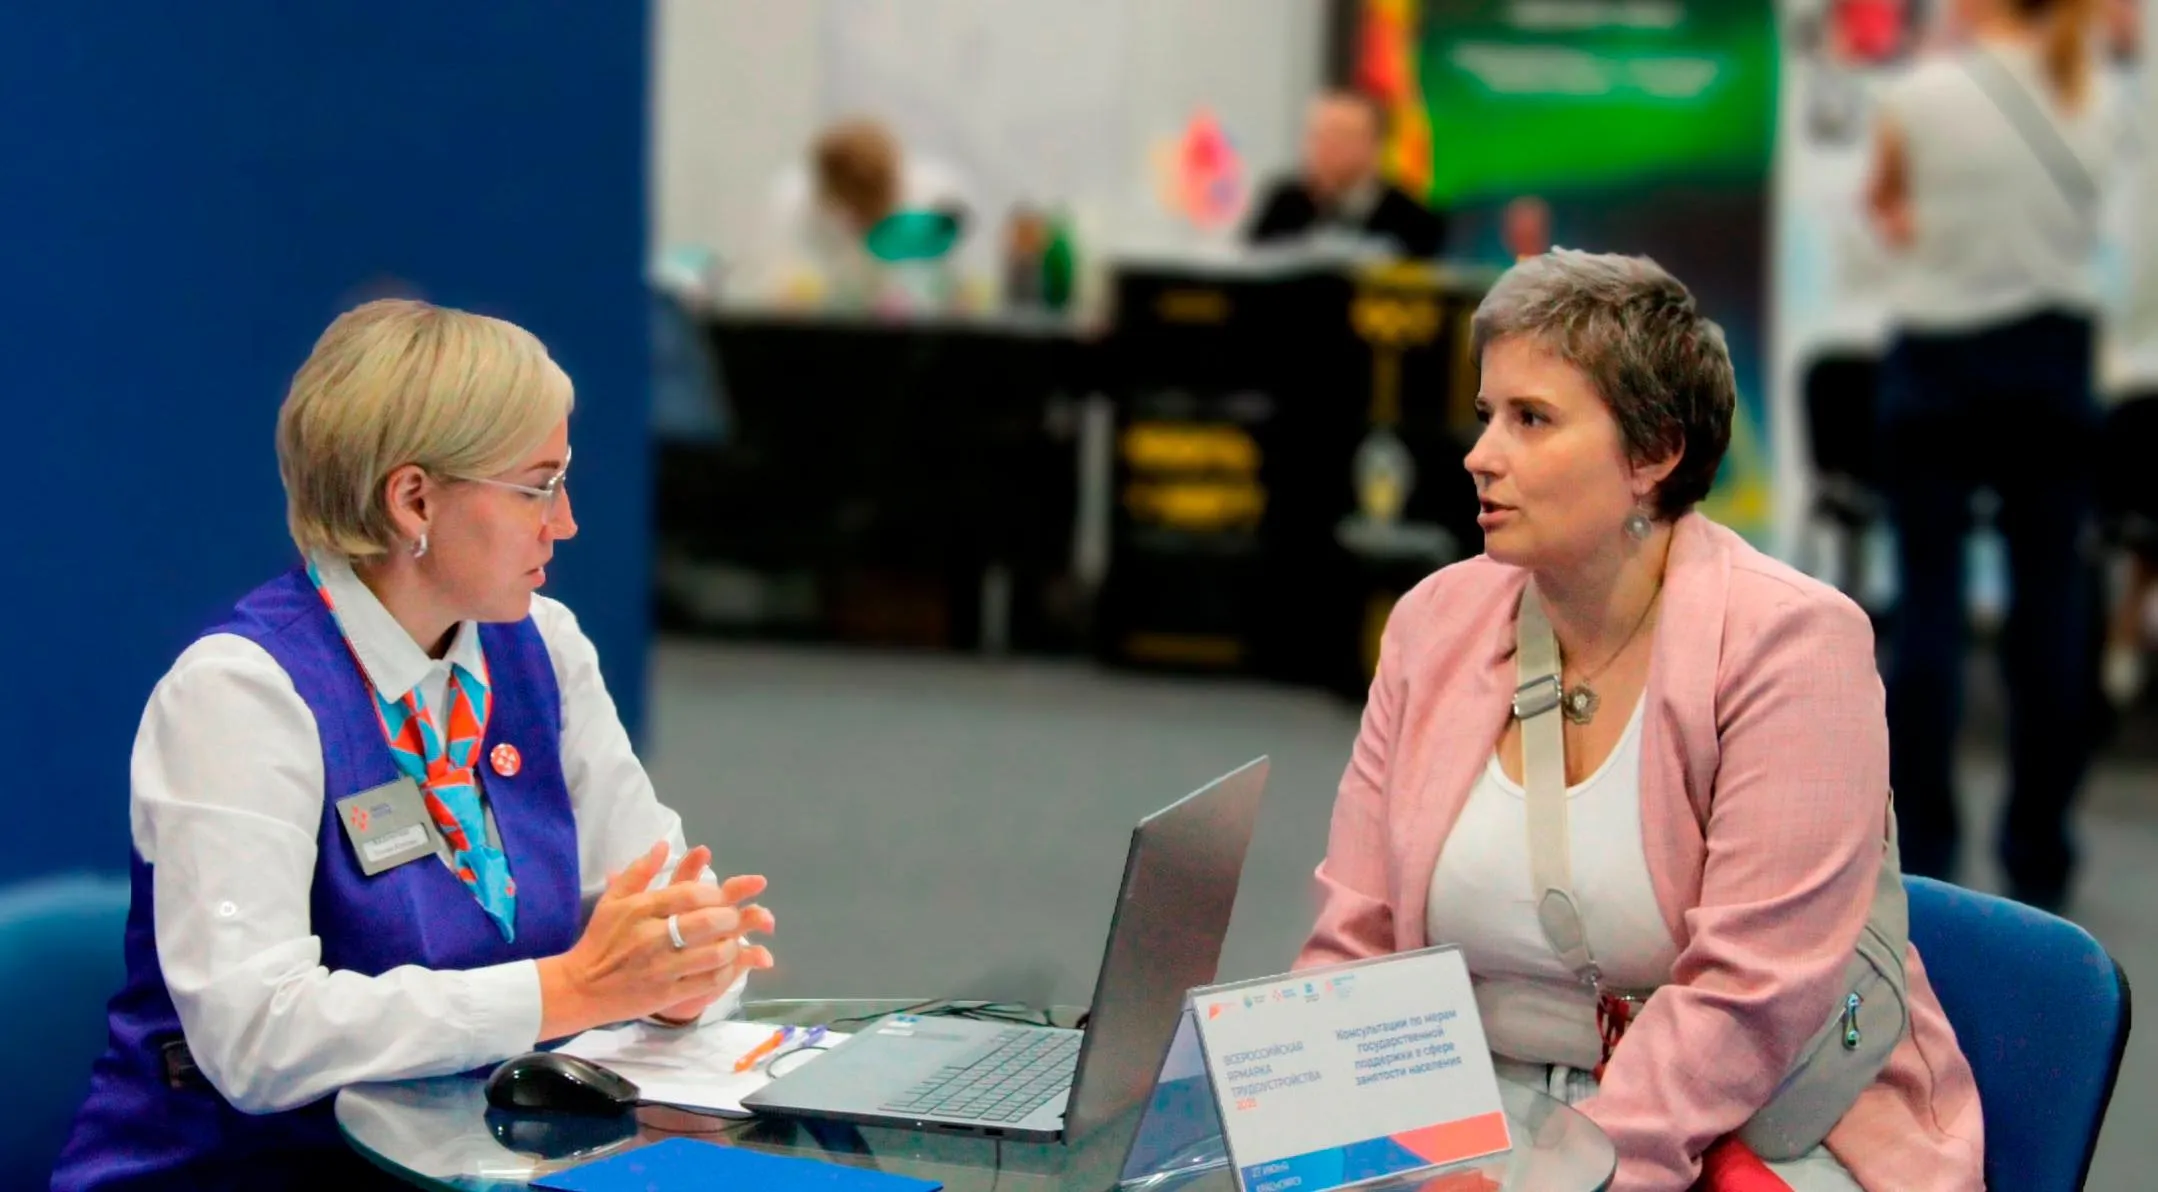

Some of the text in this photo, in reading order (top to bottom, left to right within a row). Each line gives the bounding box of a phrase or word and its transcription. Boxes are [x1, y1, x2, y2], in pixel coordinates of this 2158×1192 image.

[1335, 1009, 1457, 1040] Консультации по мерам
[1223, 1040, 1304, 1066] ВСЕРОССИЙСКАЯ
[1357, 1026, 1444, 1053] государственной
[1355, 1050, 1413, 1069] поддержки
[1423, 1042, 1454, 1056] сфере
[1226, 1063, 1273, 1082] ЯРМАРКА
[1231, 1069, 1322, 1098] ТРУДОУСТРОЙСТВА
[1356, 1056, 1463, 1086] занятости населения
